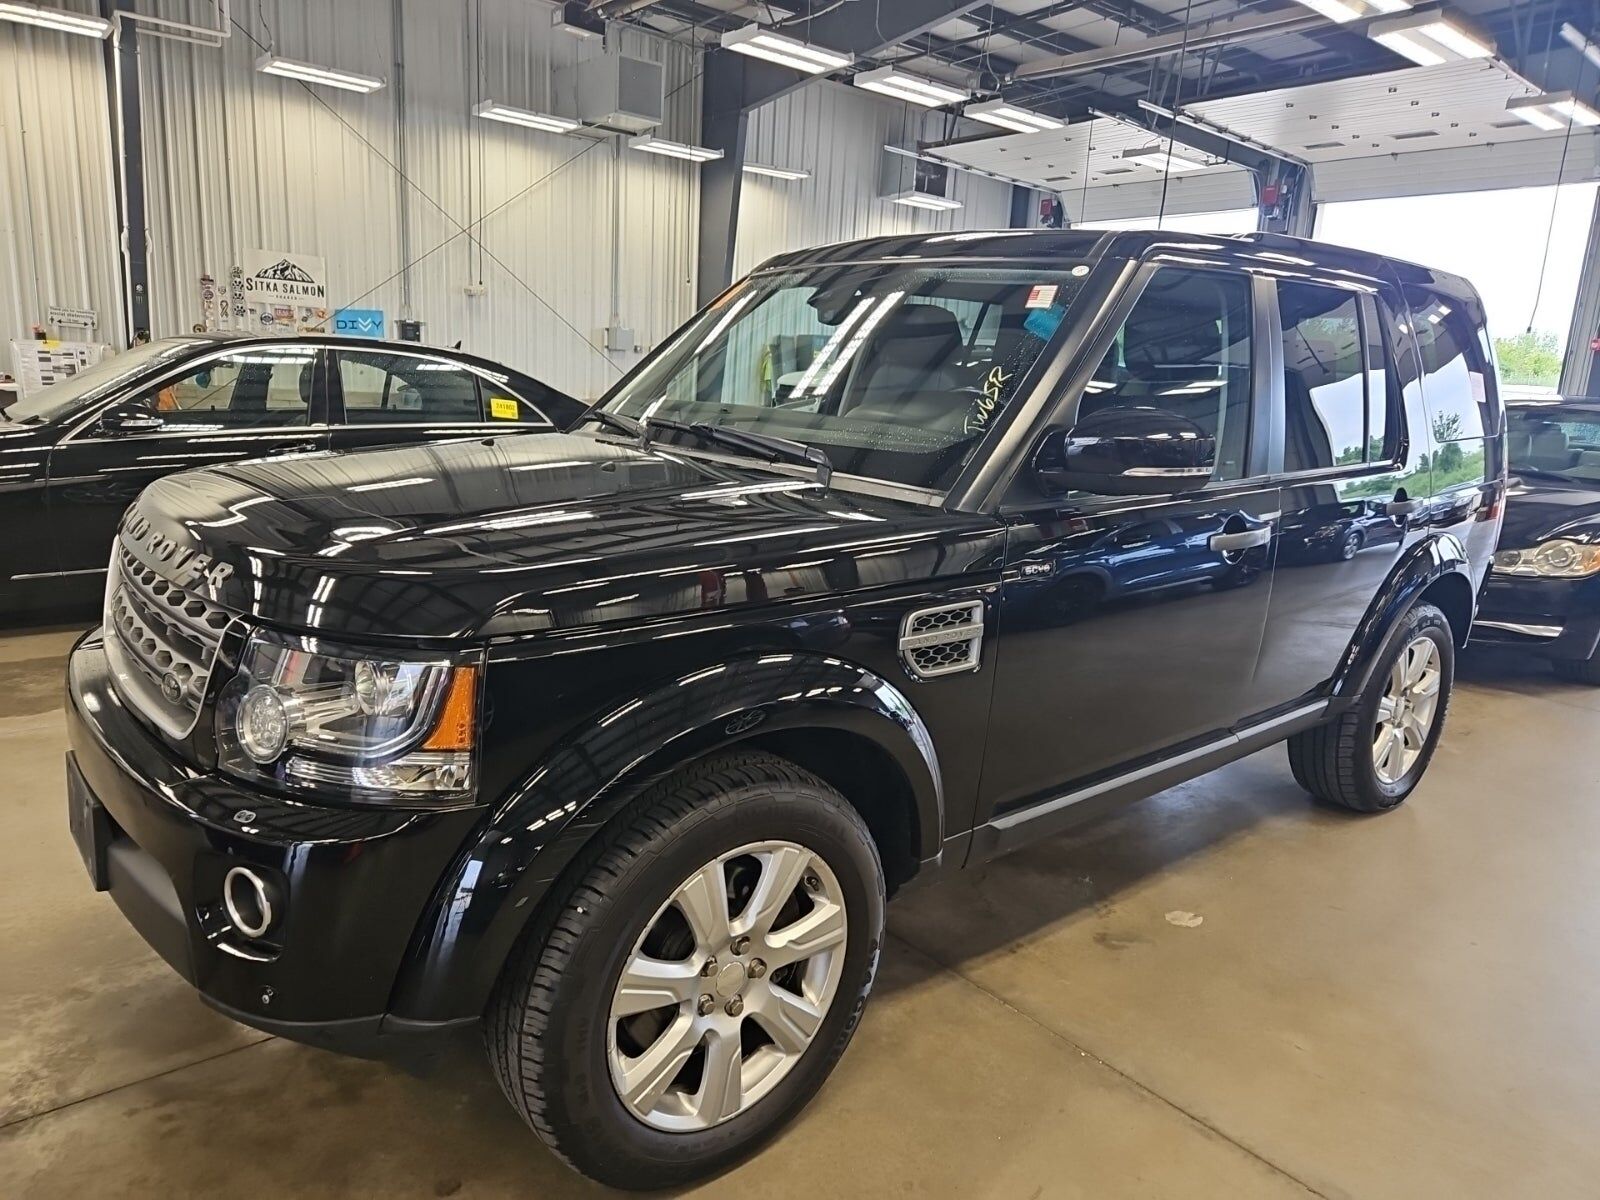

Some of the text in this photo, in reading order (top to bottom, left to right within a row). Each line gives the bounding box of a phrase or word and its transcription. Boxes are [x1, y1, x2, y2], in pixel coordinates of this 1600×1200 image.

[246, 277, 324, 298] SITKA SALMON
[146, 531, 235, 589] ROVER
